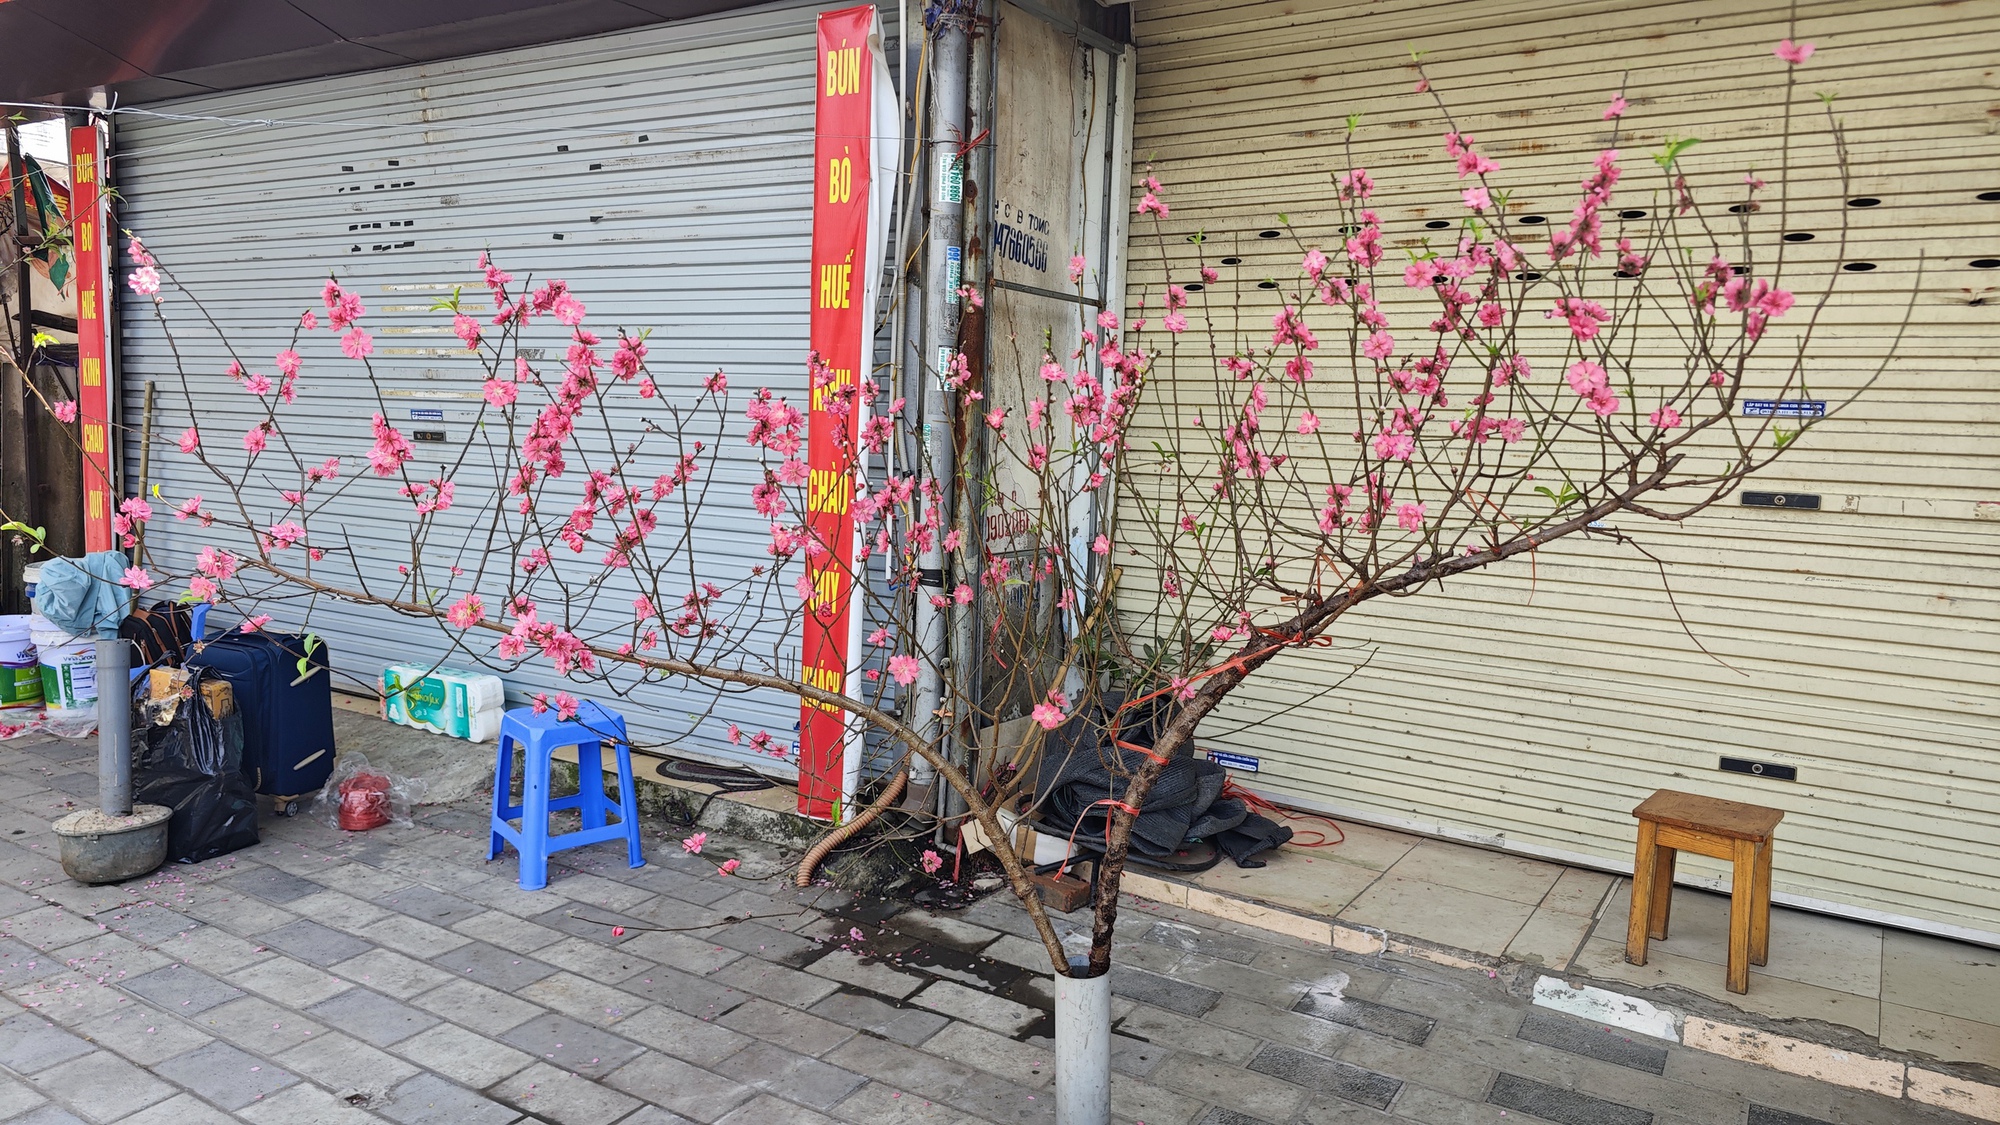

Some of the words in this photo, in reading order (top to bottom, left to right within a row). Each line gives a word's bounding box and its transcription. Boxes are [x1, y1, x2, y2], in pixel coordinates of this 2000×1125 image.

[826, 38, 861, 97] BÚN
[76, 147, 94, 184] BÚN
[828, 145, 852, 204] BÒ
[81, 216, 92, 252] BÒ
[819, 248, 855, 309] HUẾ
[81, 280, 97, 320] HUẾ
[82, 351, 101, 387] KÍNH
[83, 419, 104, 454] CHÀO
[89, 485, 103, 522] QUÝ
[808, 461, 849, 516] CHÀO
[801, 659, 841, 714] KHÁCH
